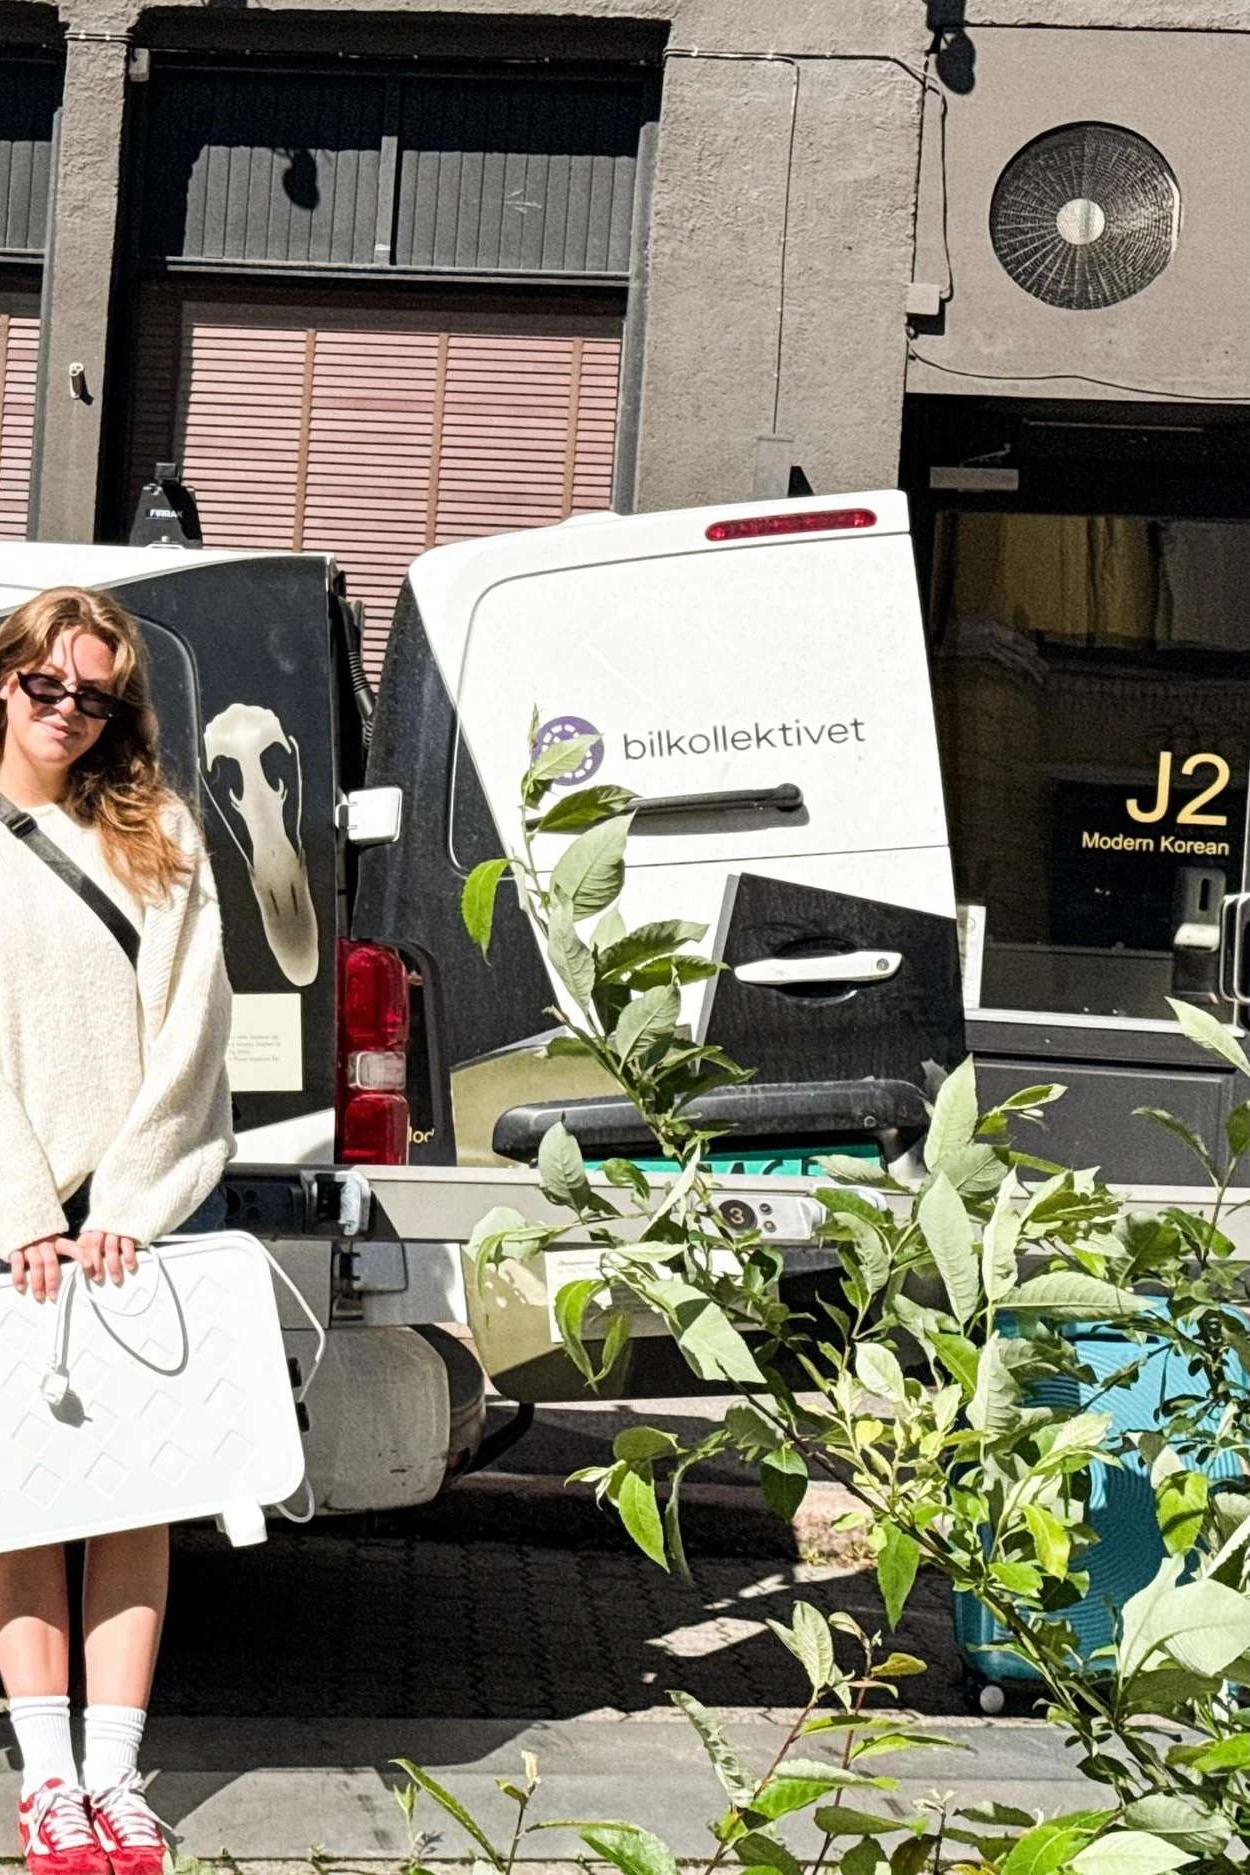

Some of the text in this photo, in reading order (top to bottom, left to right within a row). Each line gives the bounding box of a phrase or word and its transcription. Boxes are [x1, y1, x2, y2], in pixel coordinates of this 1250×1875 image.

[623, 718, 866, 760] bilkollektivet
[1126, 751, 1231, 826] J2
[1081, 831, 1230, 856] Modern Korean
[729, 1207, 745, 1225] 3
